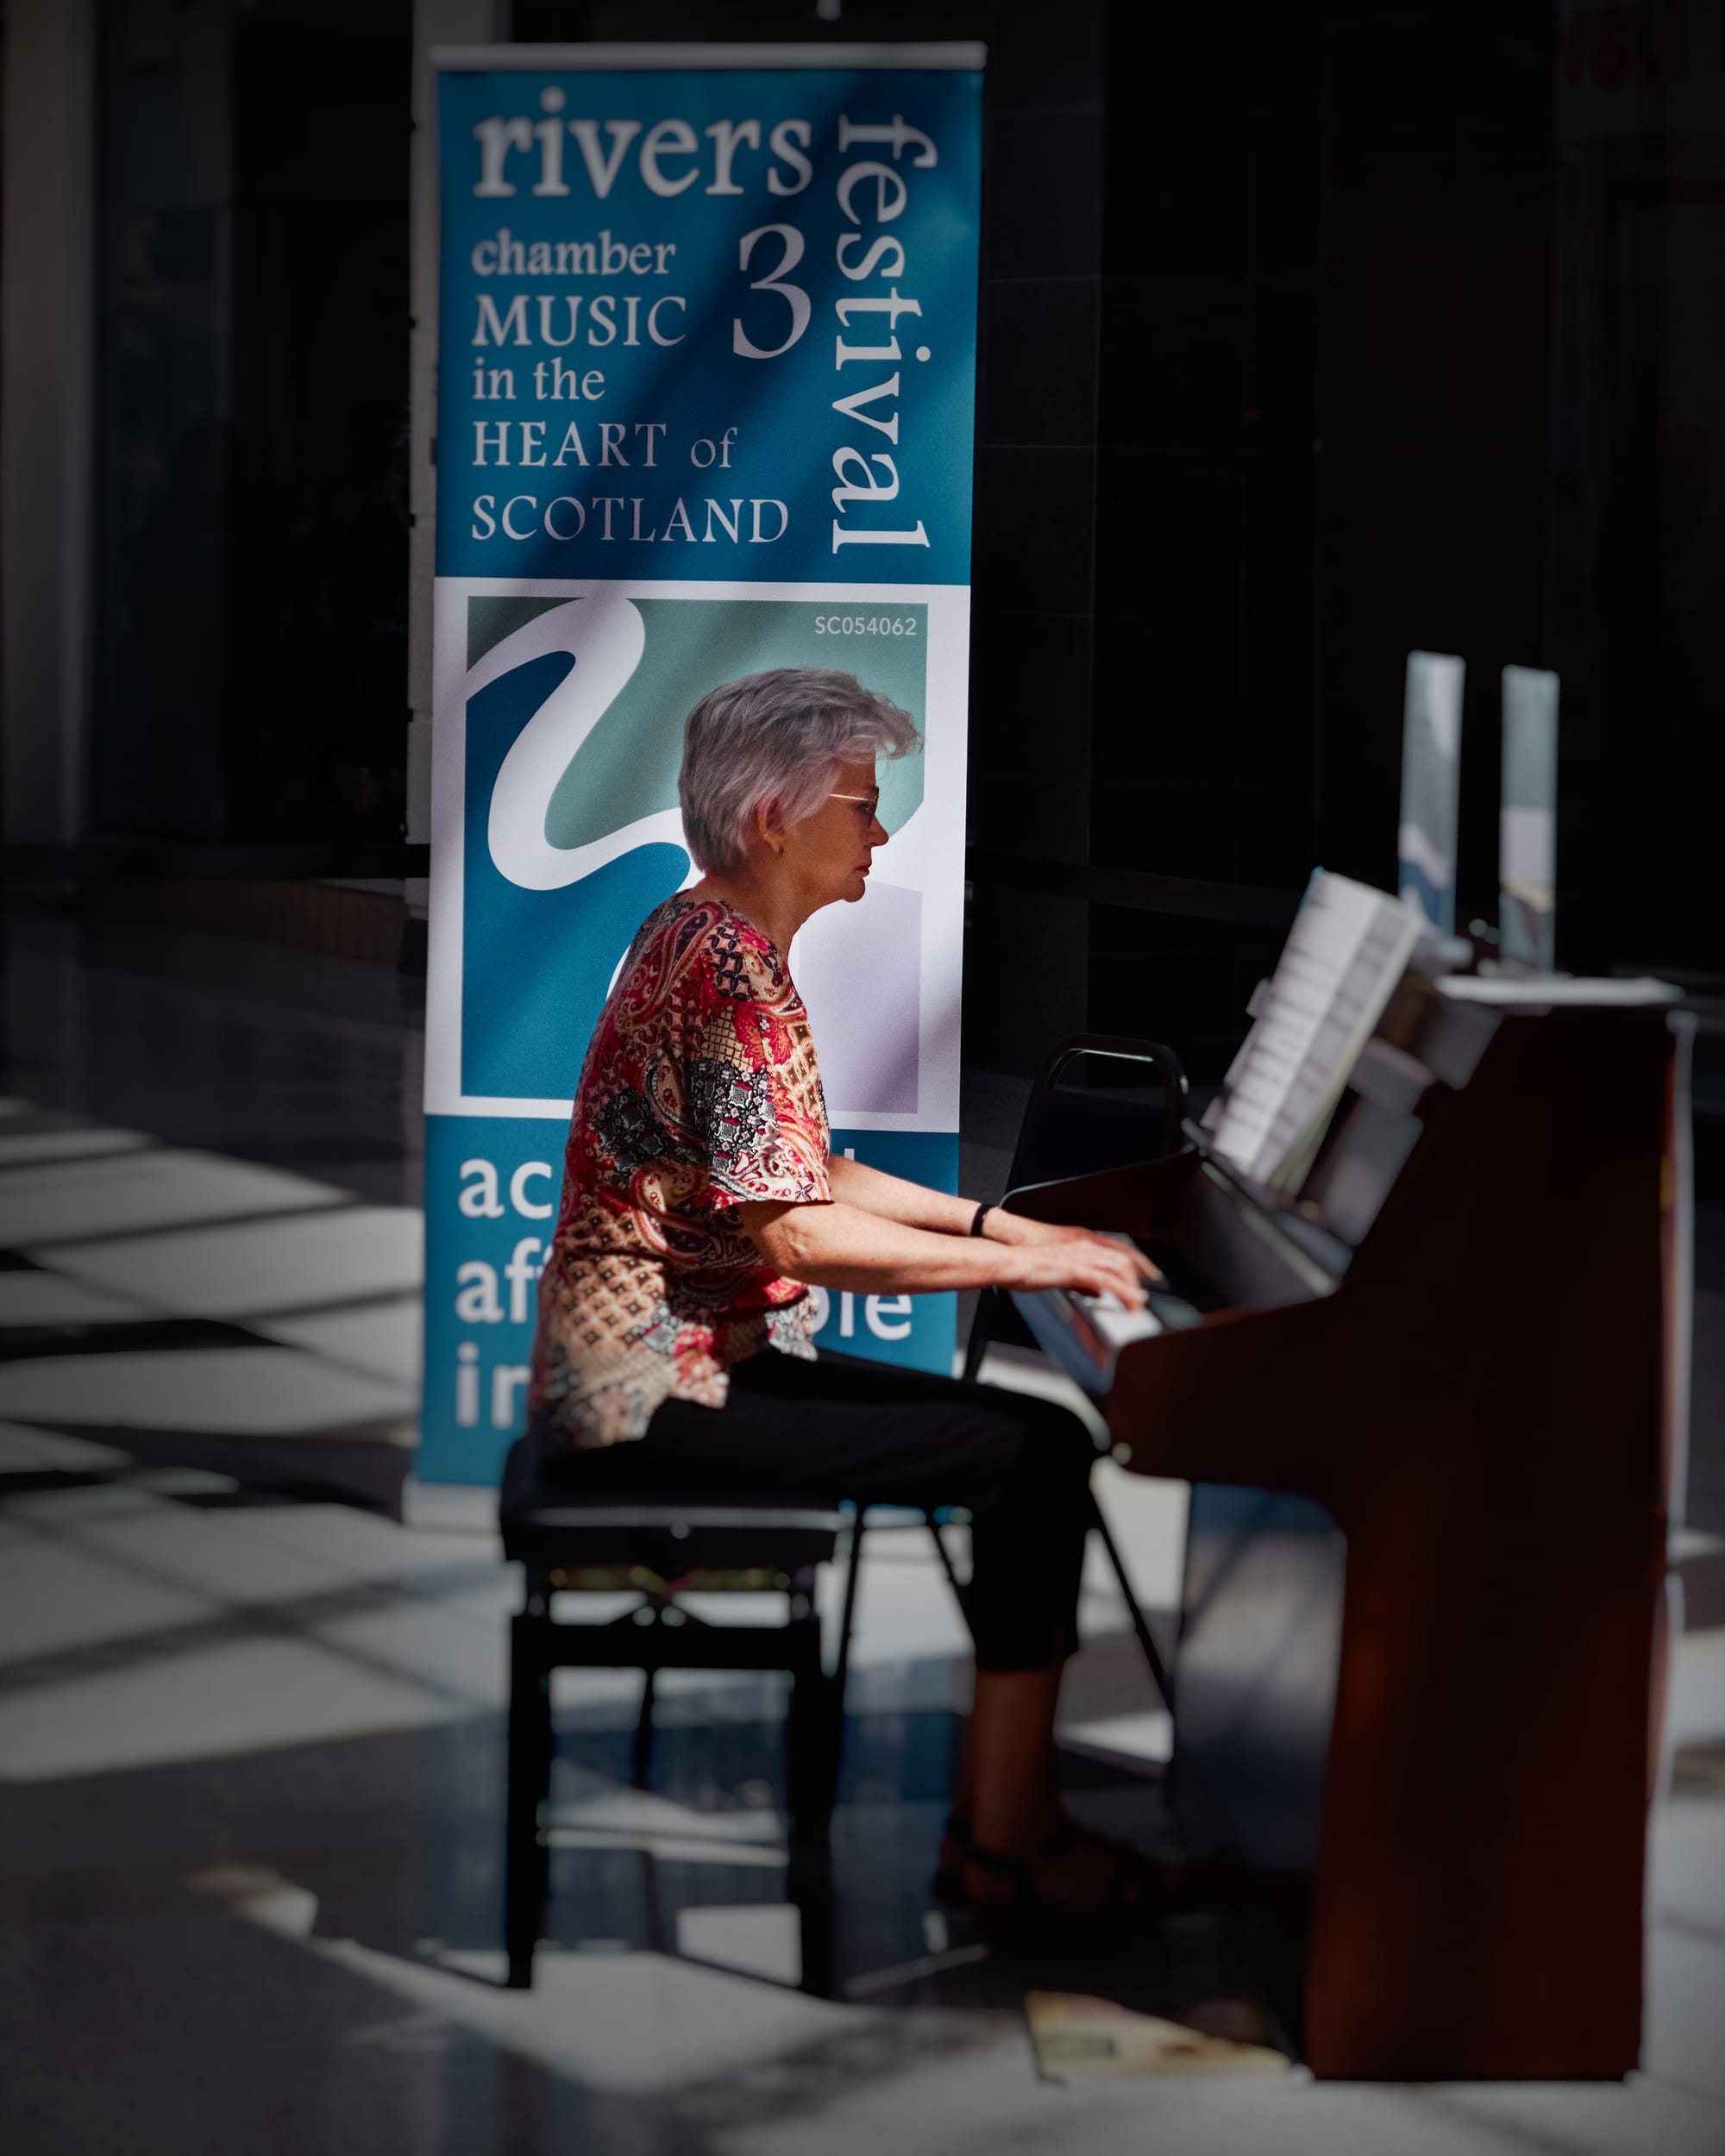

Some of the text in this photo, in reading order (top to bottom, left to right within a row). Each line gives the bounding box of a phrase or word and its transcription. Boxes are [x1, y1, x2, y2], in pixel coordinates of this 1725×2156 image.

[472, 86, 813, 199] rivers
[471, 228, 678, 277] chamber
[732, 223, 812, 360] 3
[471, 294, 687, 348] MUSIC
[831, 114, 938, 555] festival
[472, 356, 605, 401] in the
[472, 420, 739, 468] HEART of
[472, 495, 790, 544] SCOTLAND
[814, 616, 918, 636] SC054062
